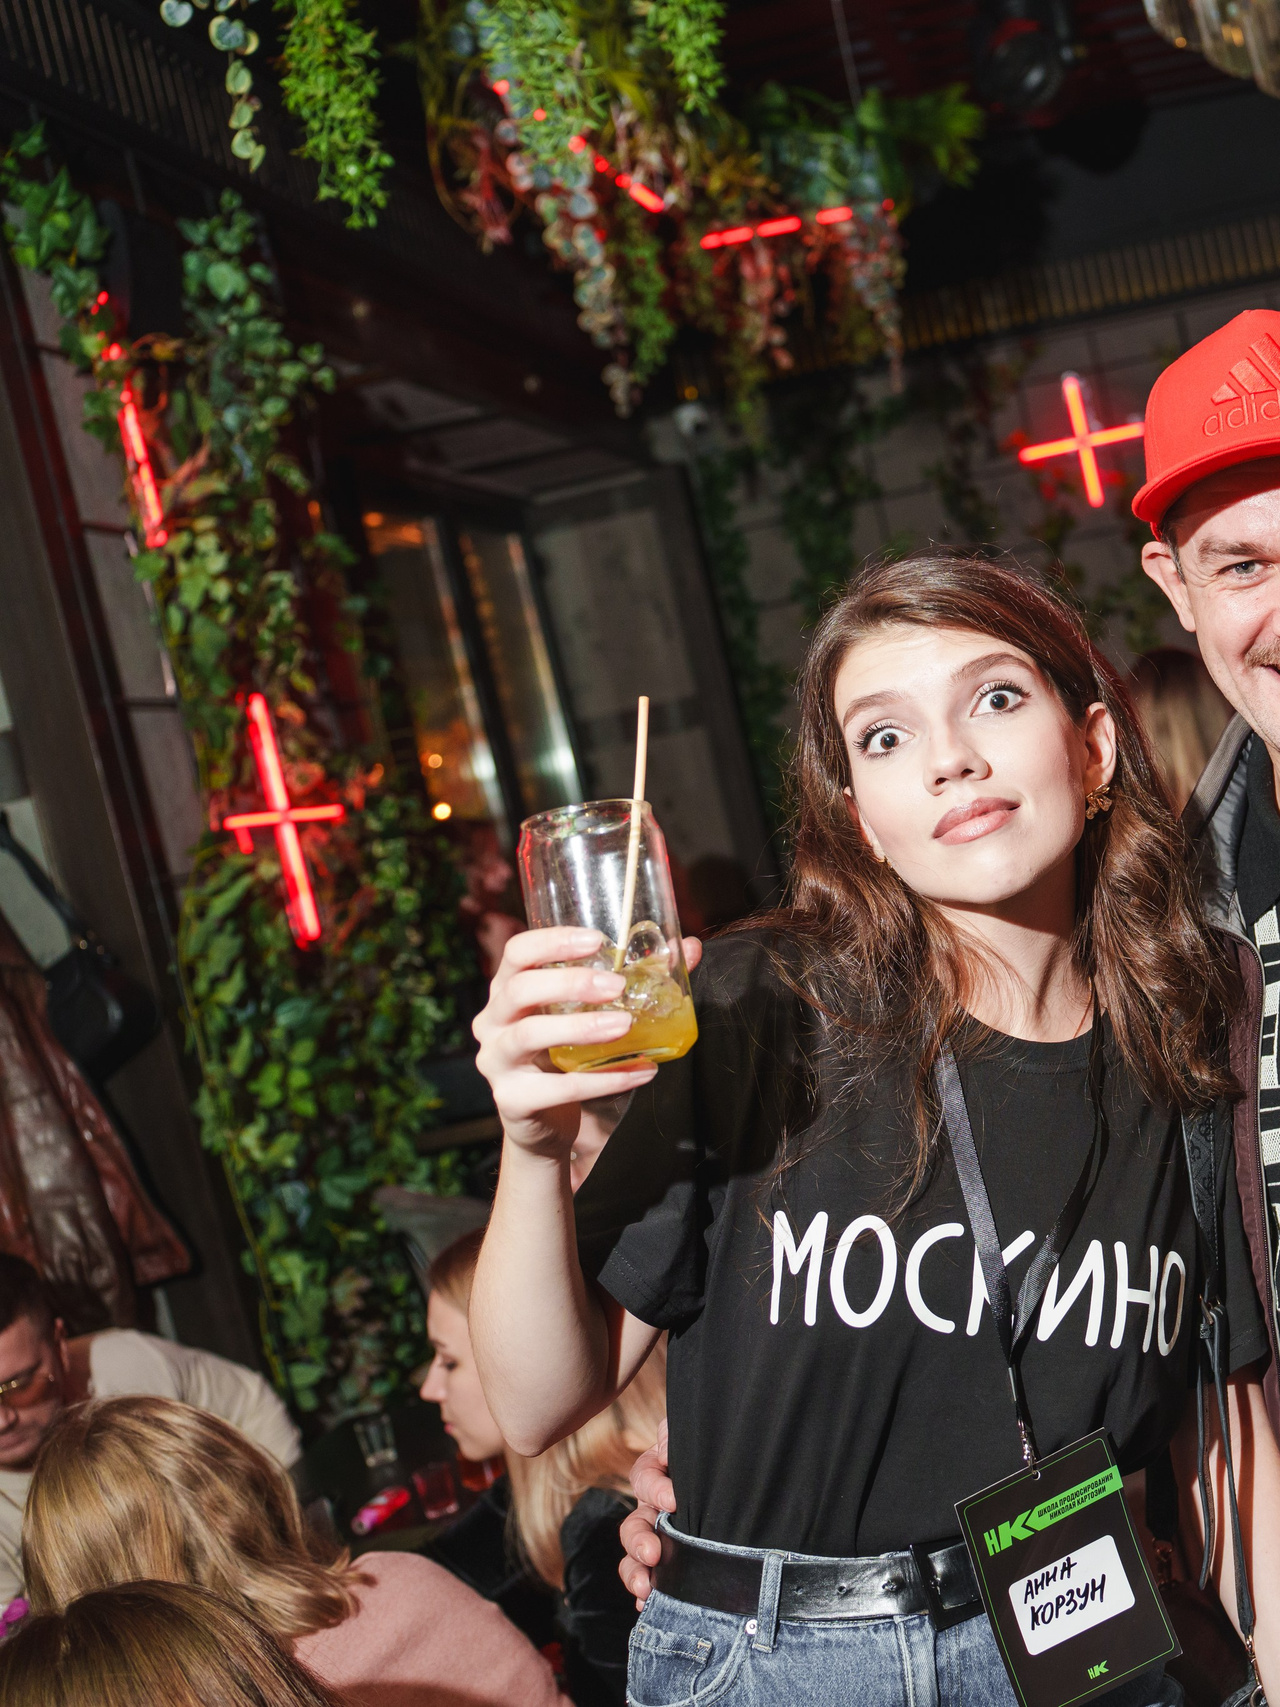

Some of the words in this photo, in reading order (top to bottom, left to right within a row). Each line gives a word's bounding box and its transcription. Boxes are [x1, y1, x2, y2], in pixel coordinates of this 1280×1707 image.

[1037, 1502, 1059, 1518] ШКОЛА
[1059, 1472, 1113, 1506] ПРОДЮСИРОВАНИЯ
[1050, 1499, 1078, 1520] НИКОЛАЯ
[1077, 1485, 1107, 1506] КАРТОЗИИ
[1023, 1556, 1077, 1605] АННА
[1030, 1573, 1106, 1630] КОРЗУН
